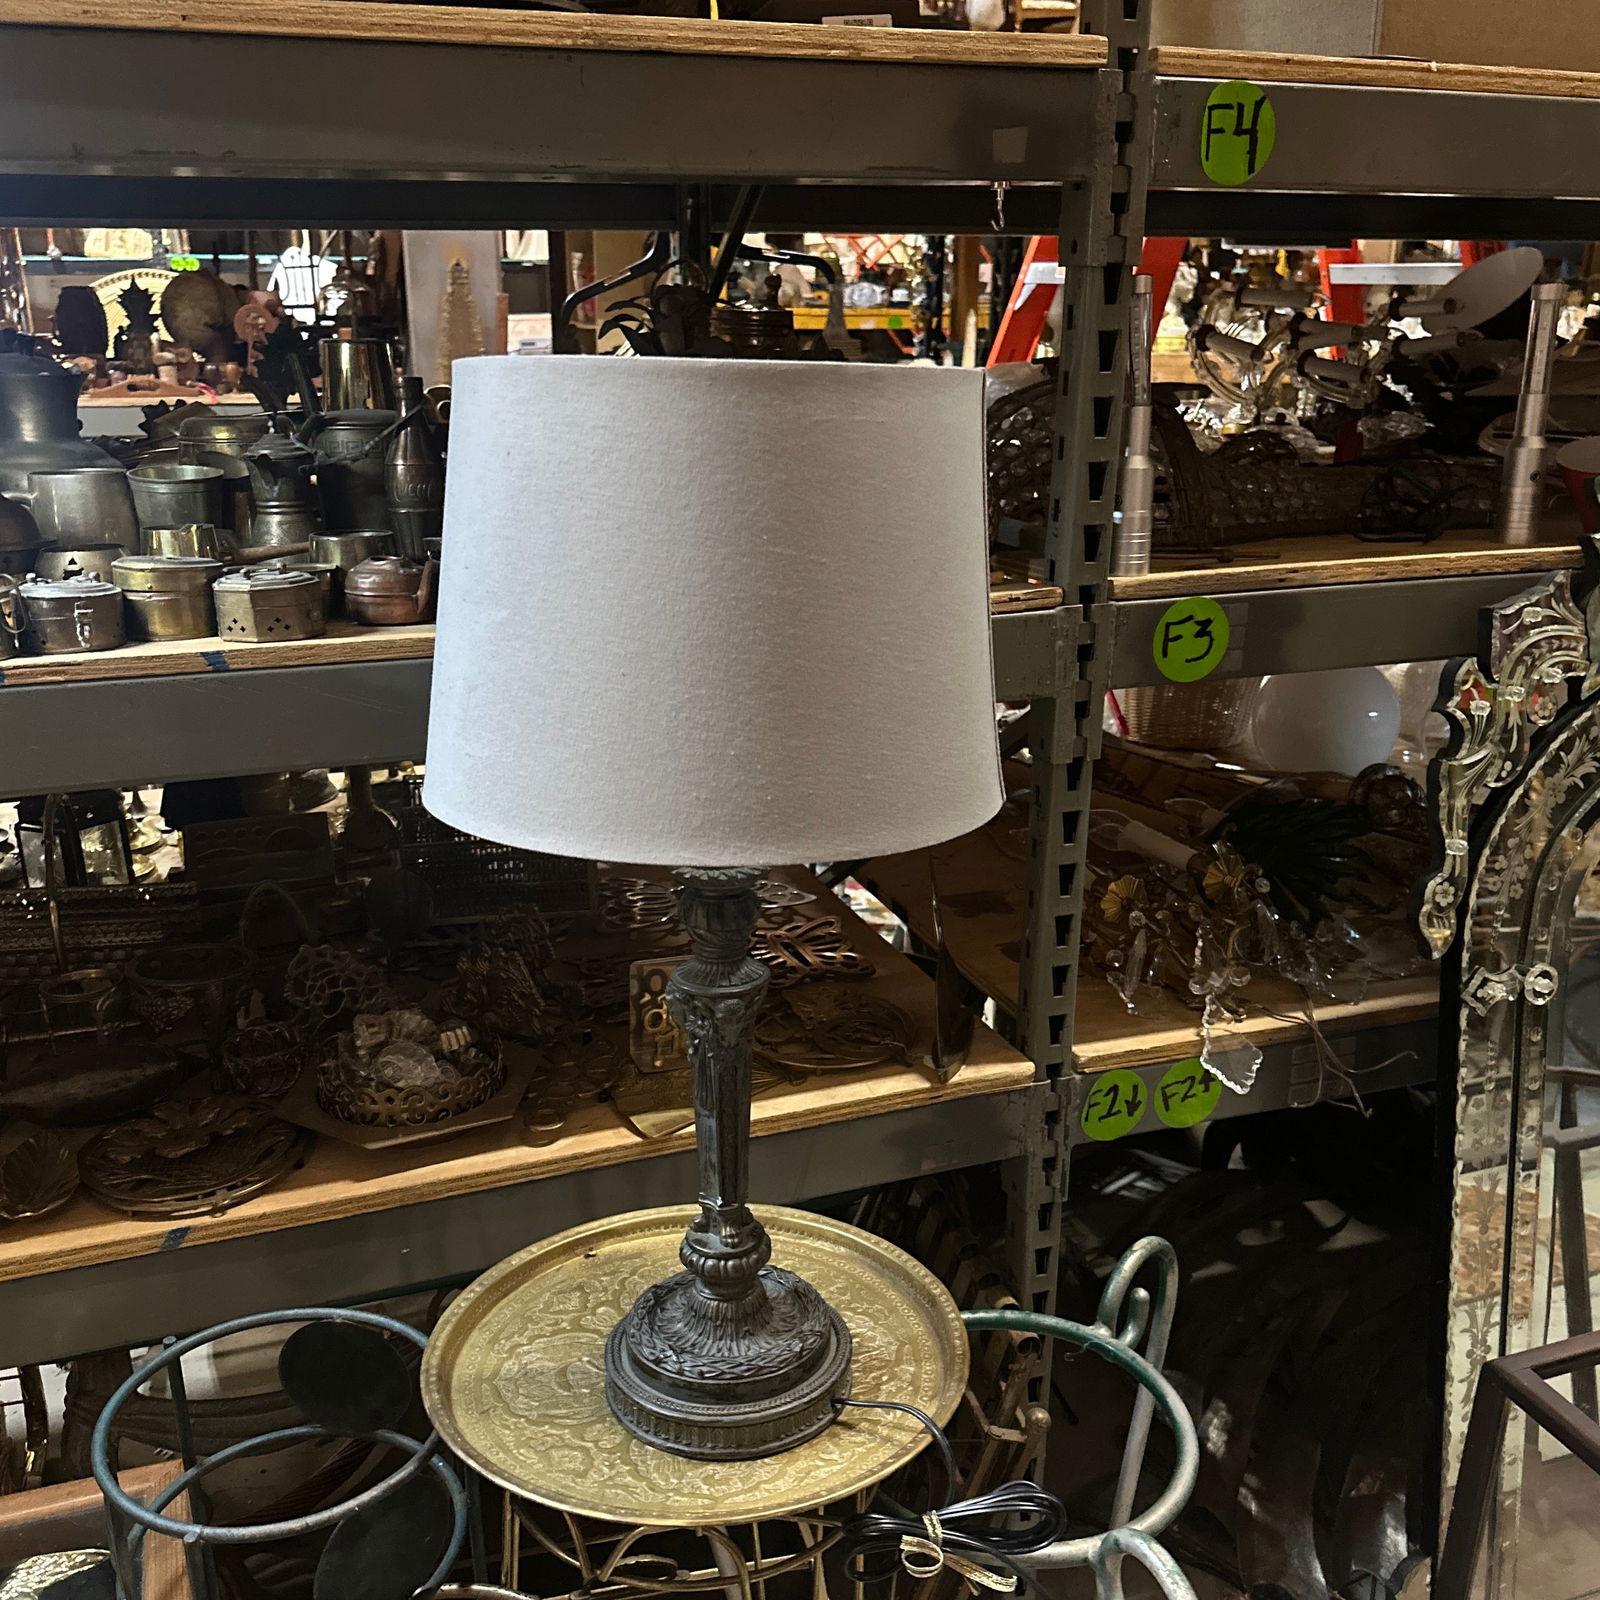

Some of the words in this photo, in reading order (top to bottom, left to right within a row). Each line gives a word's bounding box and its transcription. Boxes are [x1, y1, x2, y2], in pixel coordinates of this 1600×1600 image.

[1205, 95, 1267, 176] F4
[1162, 614, 1215, 663] F3
[1161, 1075, 1197, 1112] F2
